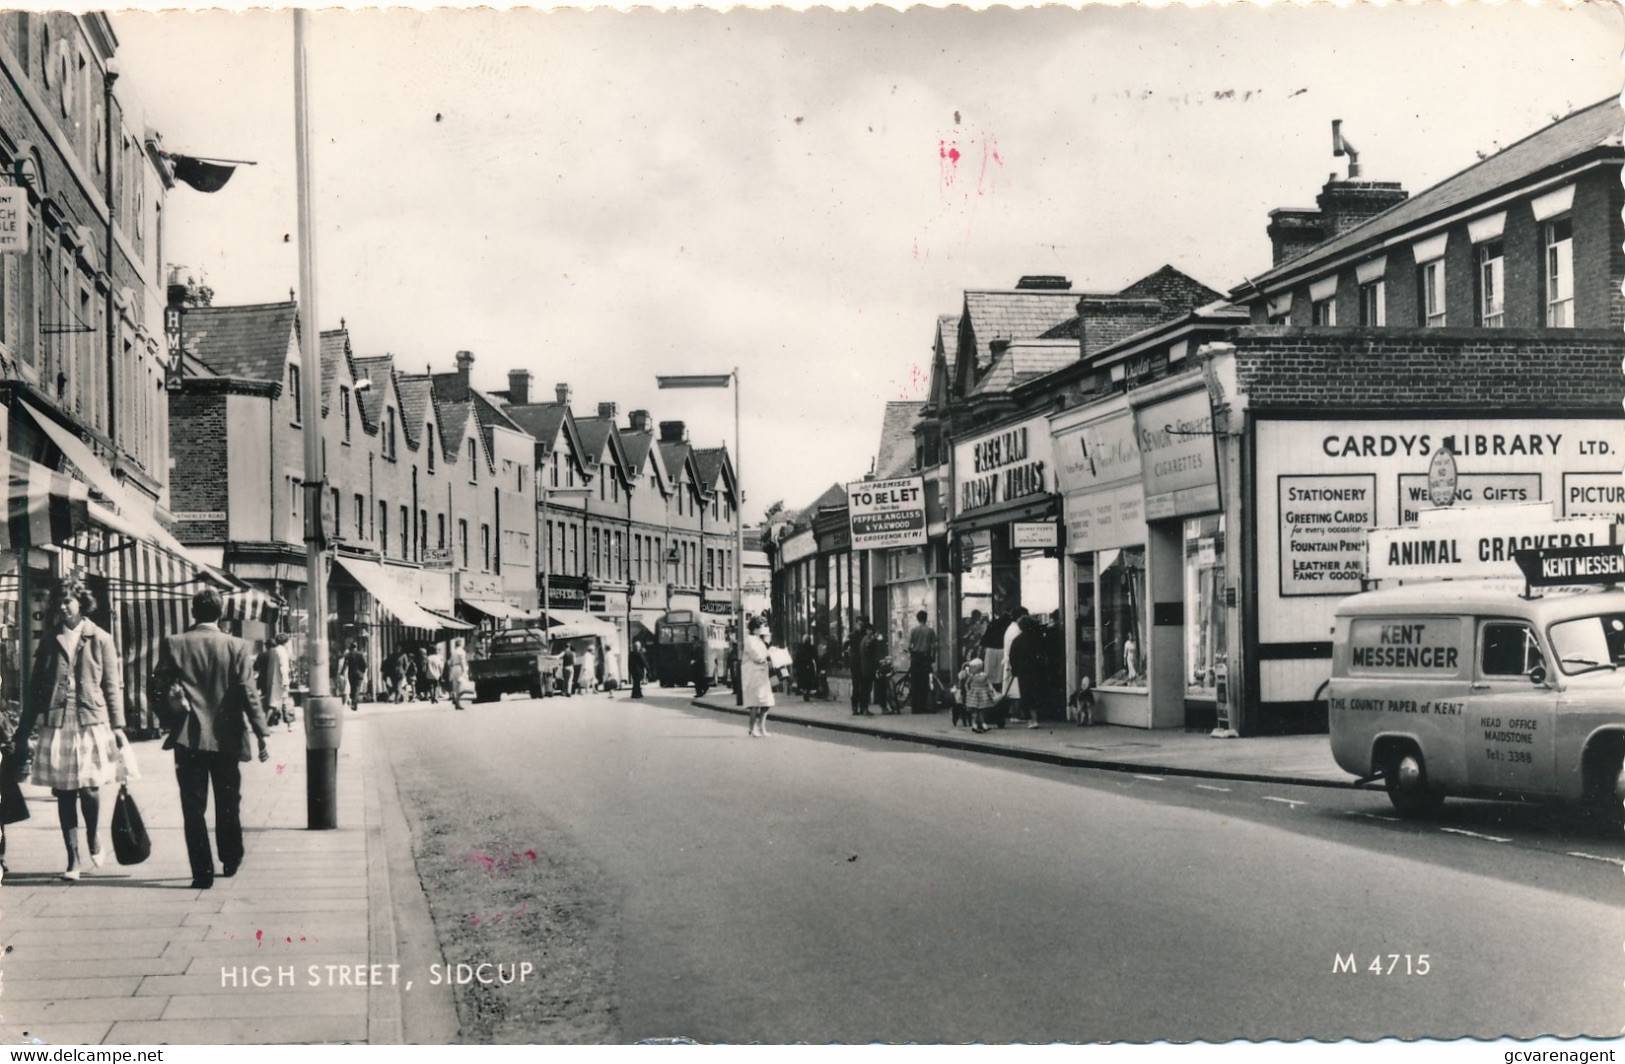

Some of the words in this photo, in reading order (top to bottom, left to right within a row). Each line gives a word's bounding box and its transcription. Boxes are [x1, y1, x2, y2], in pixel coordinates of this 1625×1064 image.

[1323, 435, 1431, 457] CARDYS
[1452, 434, 1562, 456] LIBRARY
[1579, 440, 1616, 455] LTD.
[1153, 452, 1203, 478] CIGARETTES
[872, 481, 911, 489] PREMISES
[851, 493, 873, 506] TO
[875, 492, 888, 504] BE
[890, 488, 919, 503] LET
[1289, 487, 1366, 501] STATIONERY
[1409, 487, 1471, 501] WENG
[1483, 487, 1527, 501] GIFTS
[1286, 512, 1332, 524] GREETING
[1334, 511, 1368, 523] CARDS
[872, 521, 910, 530] YARWOOD
[1290, 525, 1302, 537] for
[1305, 527, 1325, 535] every
[1291, 540, 1338, 552] FOUNTAIN
[1388, 539, 1461, 566] ANIMAL
[1293, 559, 1340, 570] LEATHER
[1344, 561, 1360, 570] AN
[1543, 558, 1573, 577] KENT
[1293, 571, 1325, 580] FANCY
[1329, 571, 1361, 580] GOOD
[1381, 624, 1425, 644] KENT
[1352, 646, 1458, 667] MESSENGER
[1331, 698, 1346, 710] THE
[1350, 699, 1385, 711] COUNTY
[1388, 700, 1417, 713] PAPER
[1420, 701, 1432, 714] of
[1434, 702, 1464, 715] KENT
[1481, 718, 1501, 728] HEAD
[1509, 719, 1537, 730] OFFICE
[1484, 731, 1533, 744] MAIDSTONE
